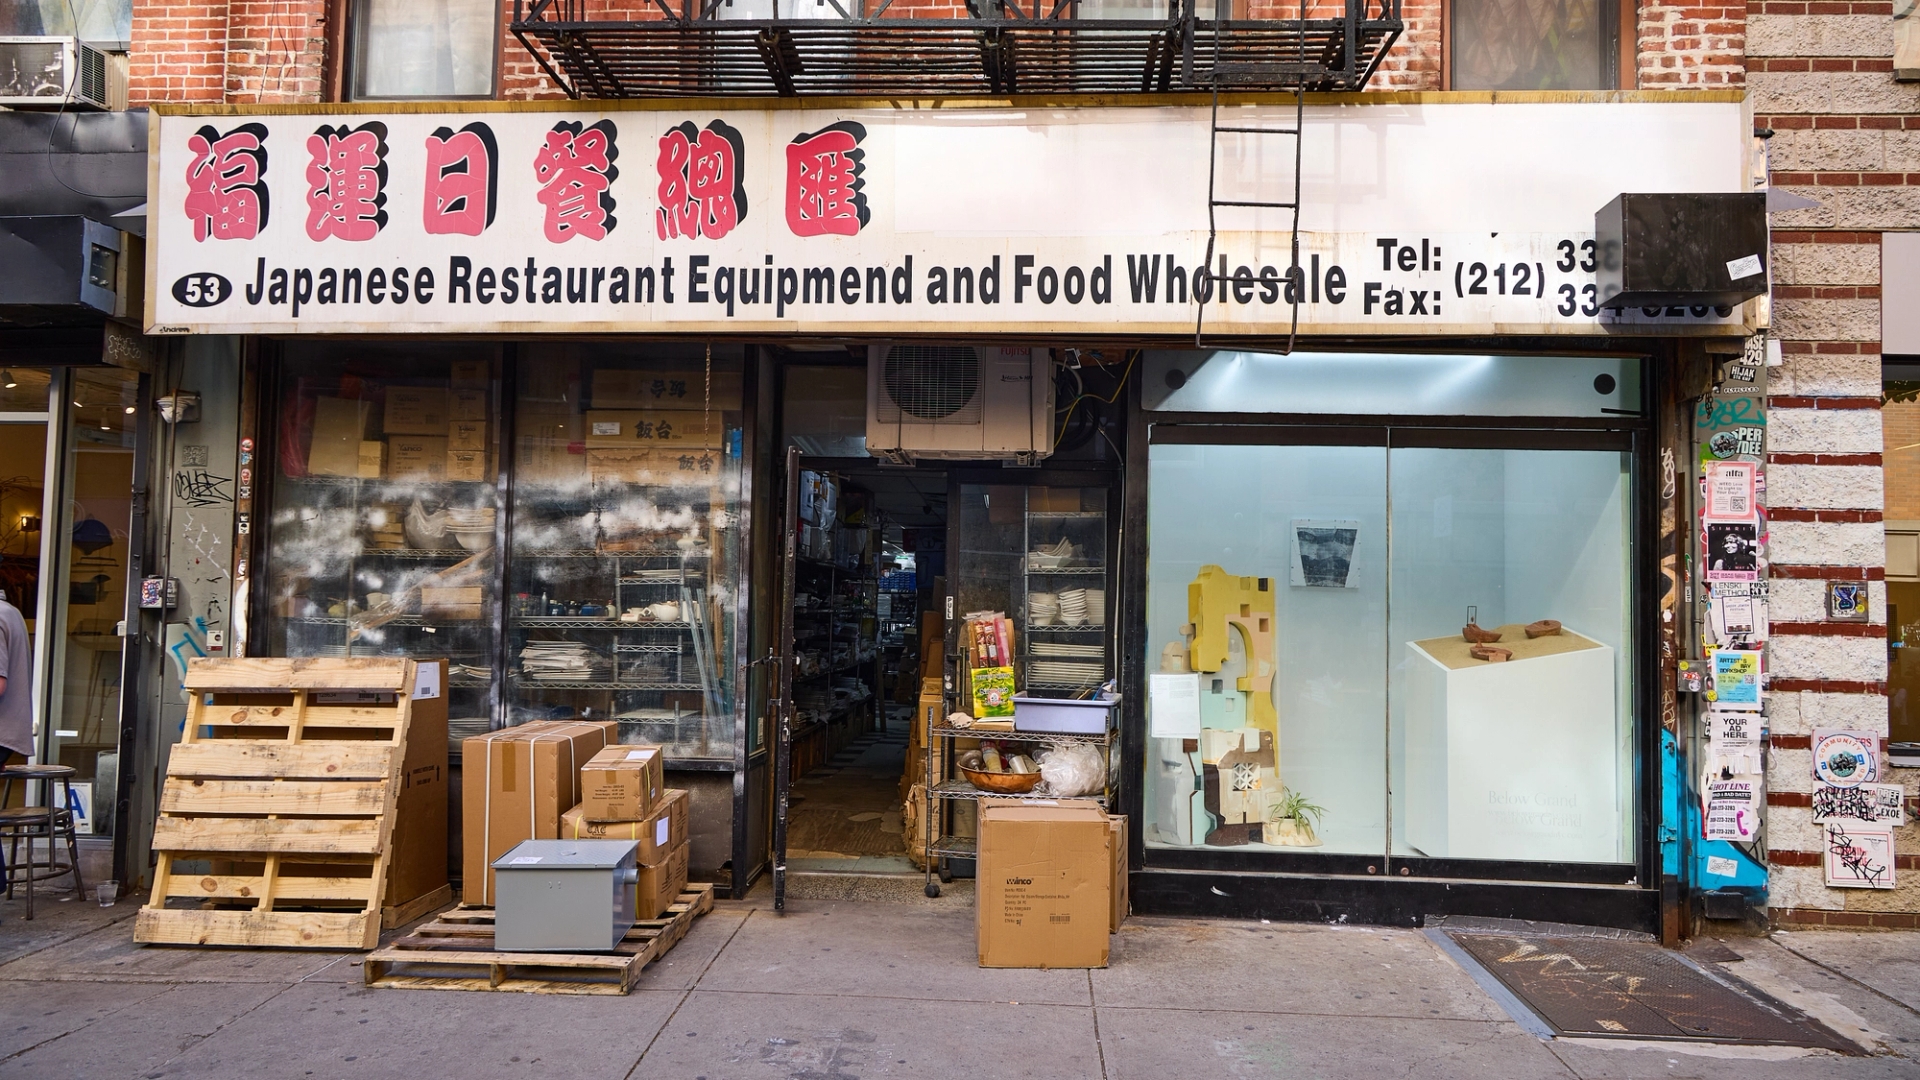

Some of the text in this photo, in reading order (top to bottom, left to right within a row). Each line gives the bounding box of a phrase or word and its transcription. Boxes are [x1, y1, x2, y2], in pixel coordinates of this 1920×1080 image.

[1376, 238, 1442, 272] Tel:
[184, 253, 1347, 318] 53 Japanese Restaurant Equipmend and Food Wholesale
[1363, 282, 1442, 317] Fax:
[1454, 262, 1545, 299] (212)
[1001, 347, 1031, 357] FUJITSU
[1731, 366, 1755, 378] HIJAK
[634, 419, 673, 440] 飯台
[677, 454, 714, 472] 飯台
[1725, 469, 1743, 477] alfa
[1723, 731, 1748, 739] HERE
[1818, 738, 1862, 758] COMMUNITY
[63, 789, 85, 819] A
[1488, 790, 1578, 808] Below Grand
